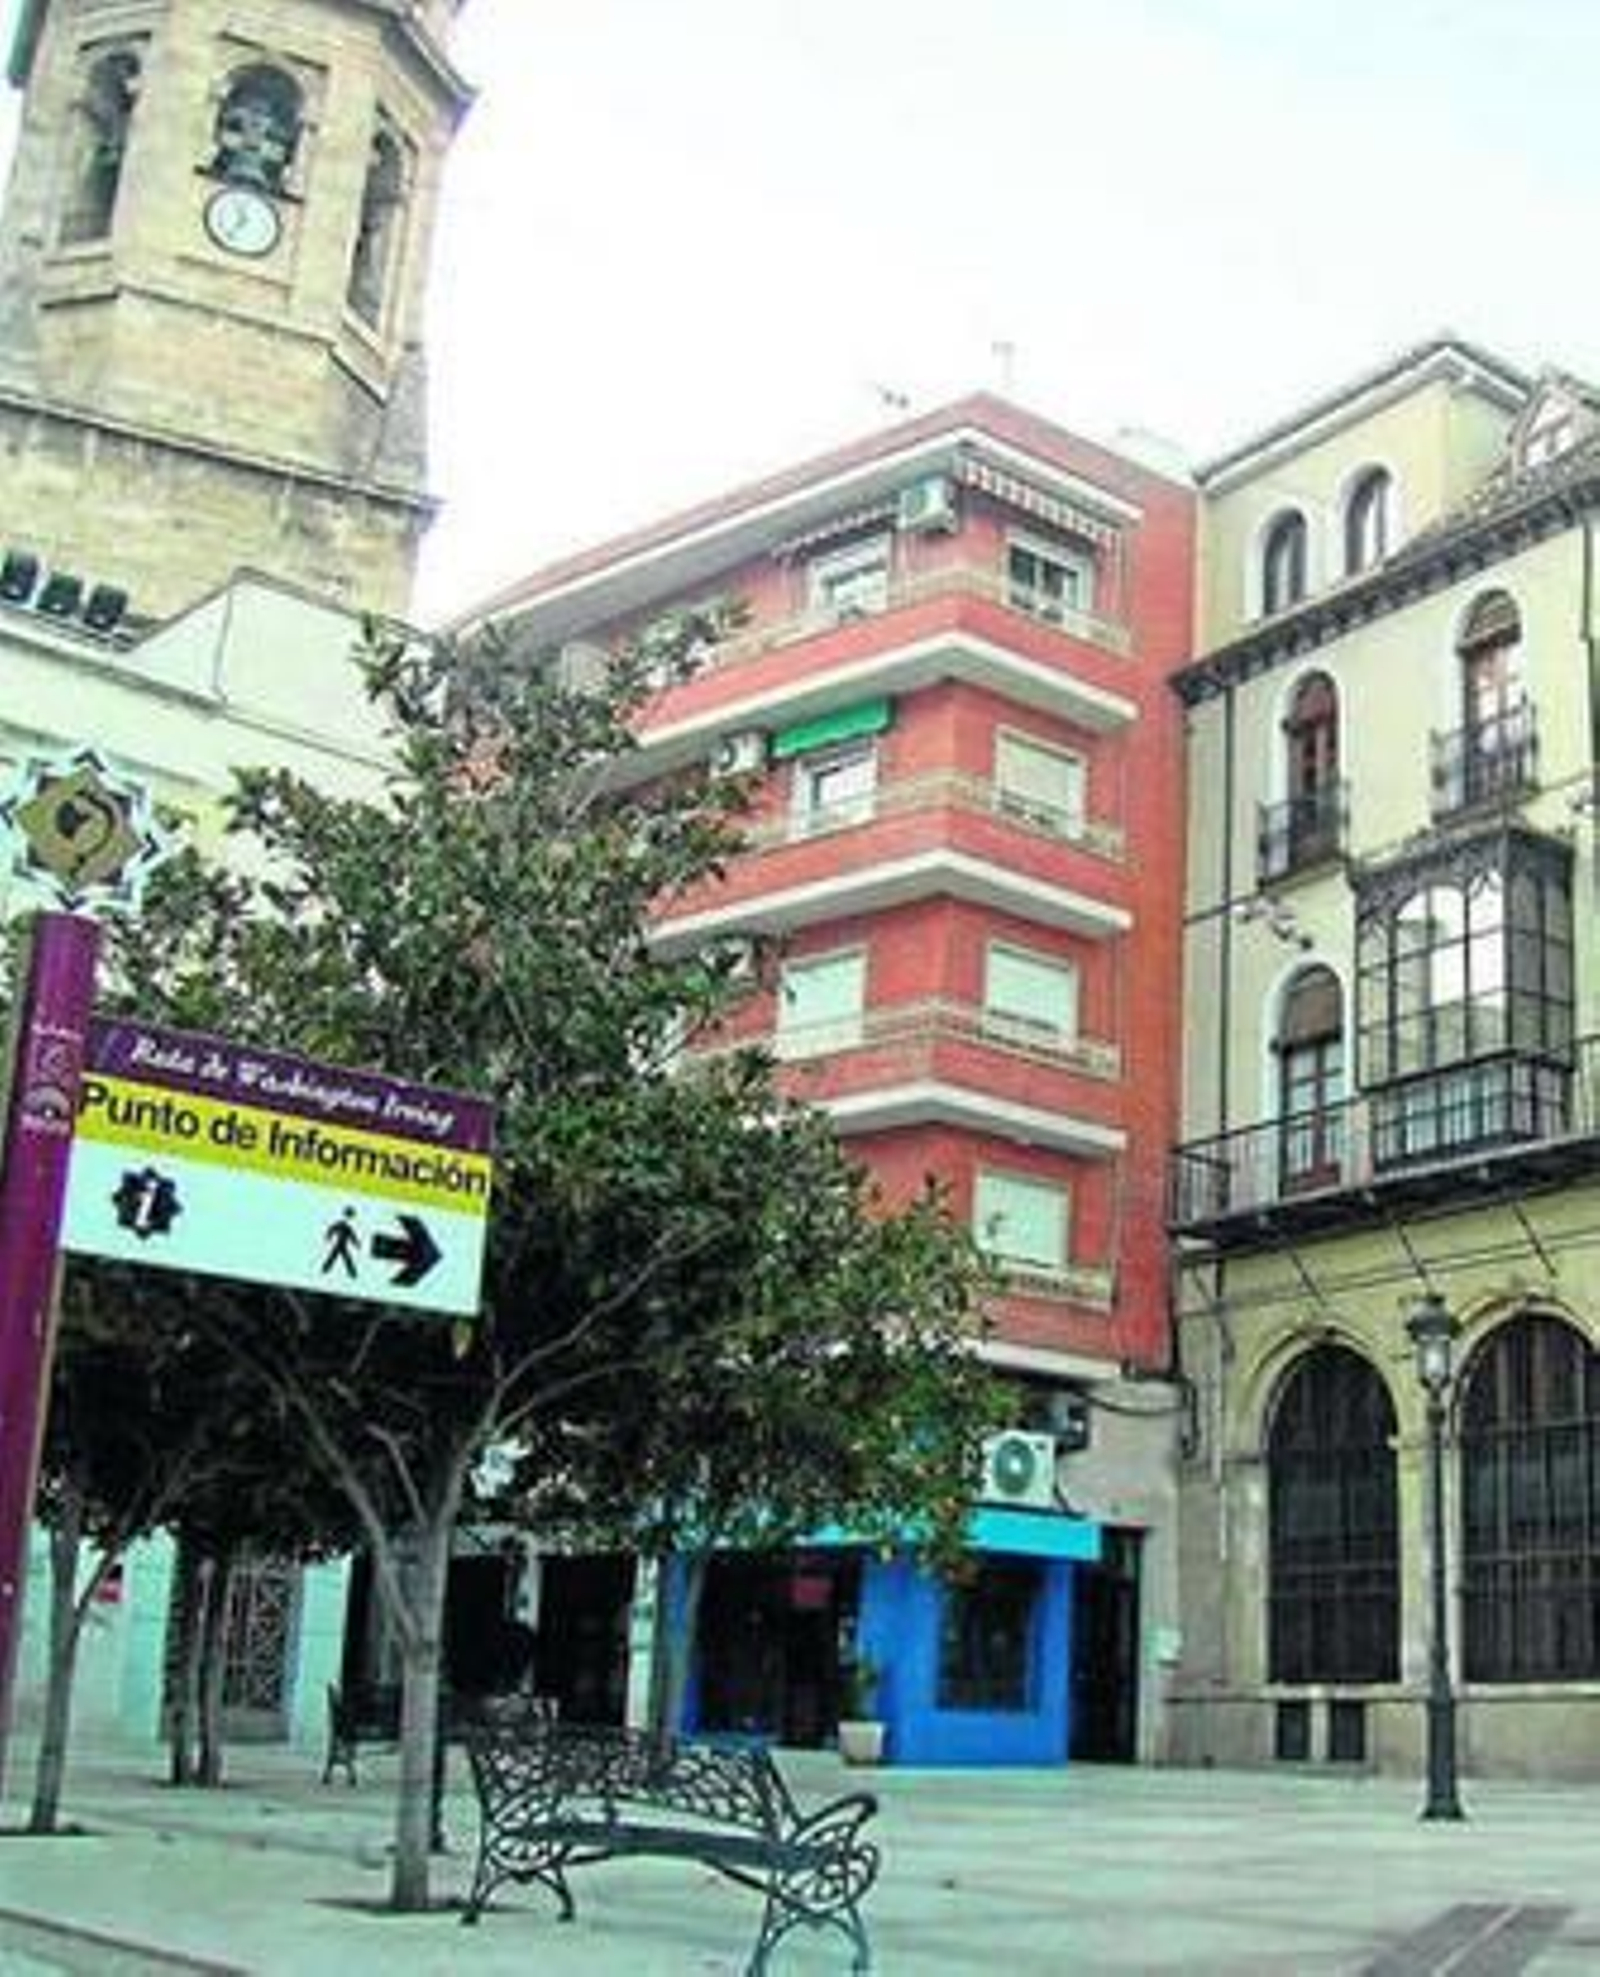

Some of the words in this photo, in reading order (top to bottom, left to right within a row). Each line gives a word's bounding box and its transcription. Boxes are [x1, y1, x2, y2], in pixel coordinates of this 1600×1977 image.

[199, 1053, 228, 1081] de
[237, 1060, 379, 1114] Washington
[79, 1081, 200, 1139] Punto
[209, 1111, 258, 1149] de
[269, 1120, 487, 1197] Información
